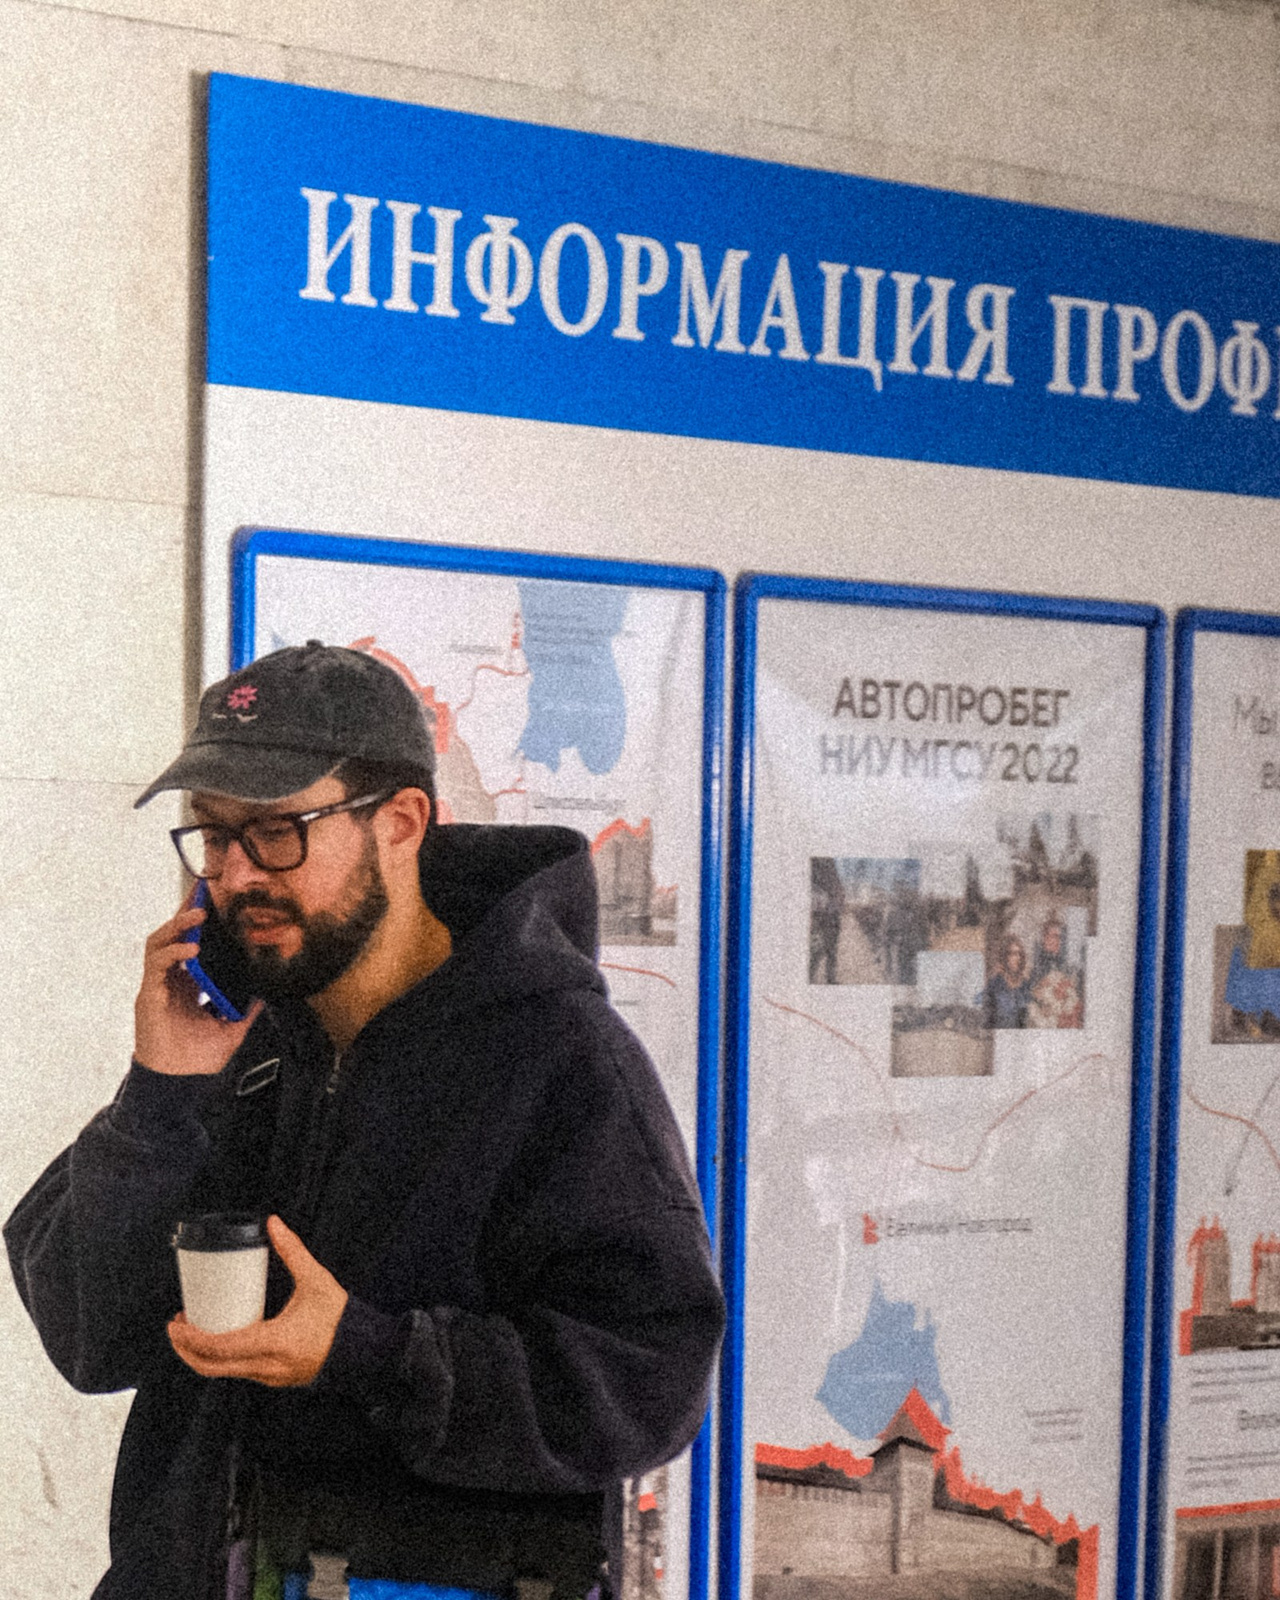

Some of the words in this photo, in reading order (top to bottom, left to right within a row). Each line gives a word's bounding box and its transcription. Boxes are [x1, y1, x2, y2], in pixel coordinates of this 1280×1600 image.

[299, 186, 1017, 393] ИНФОРМАЦИЯ
[1046, 294, 1280, 420] ПРОФ
[833, 677, 1071, 728] АВТОПРОБЕГ
[1000, 742, 1079, 784] 2022
